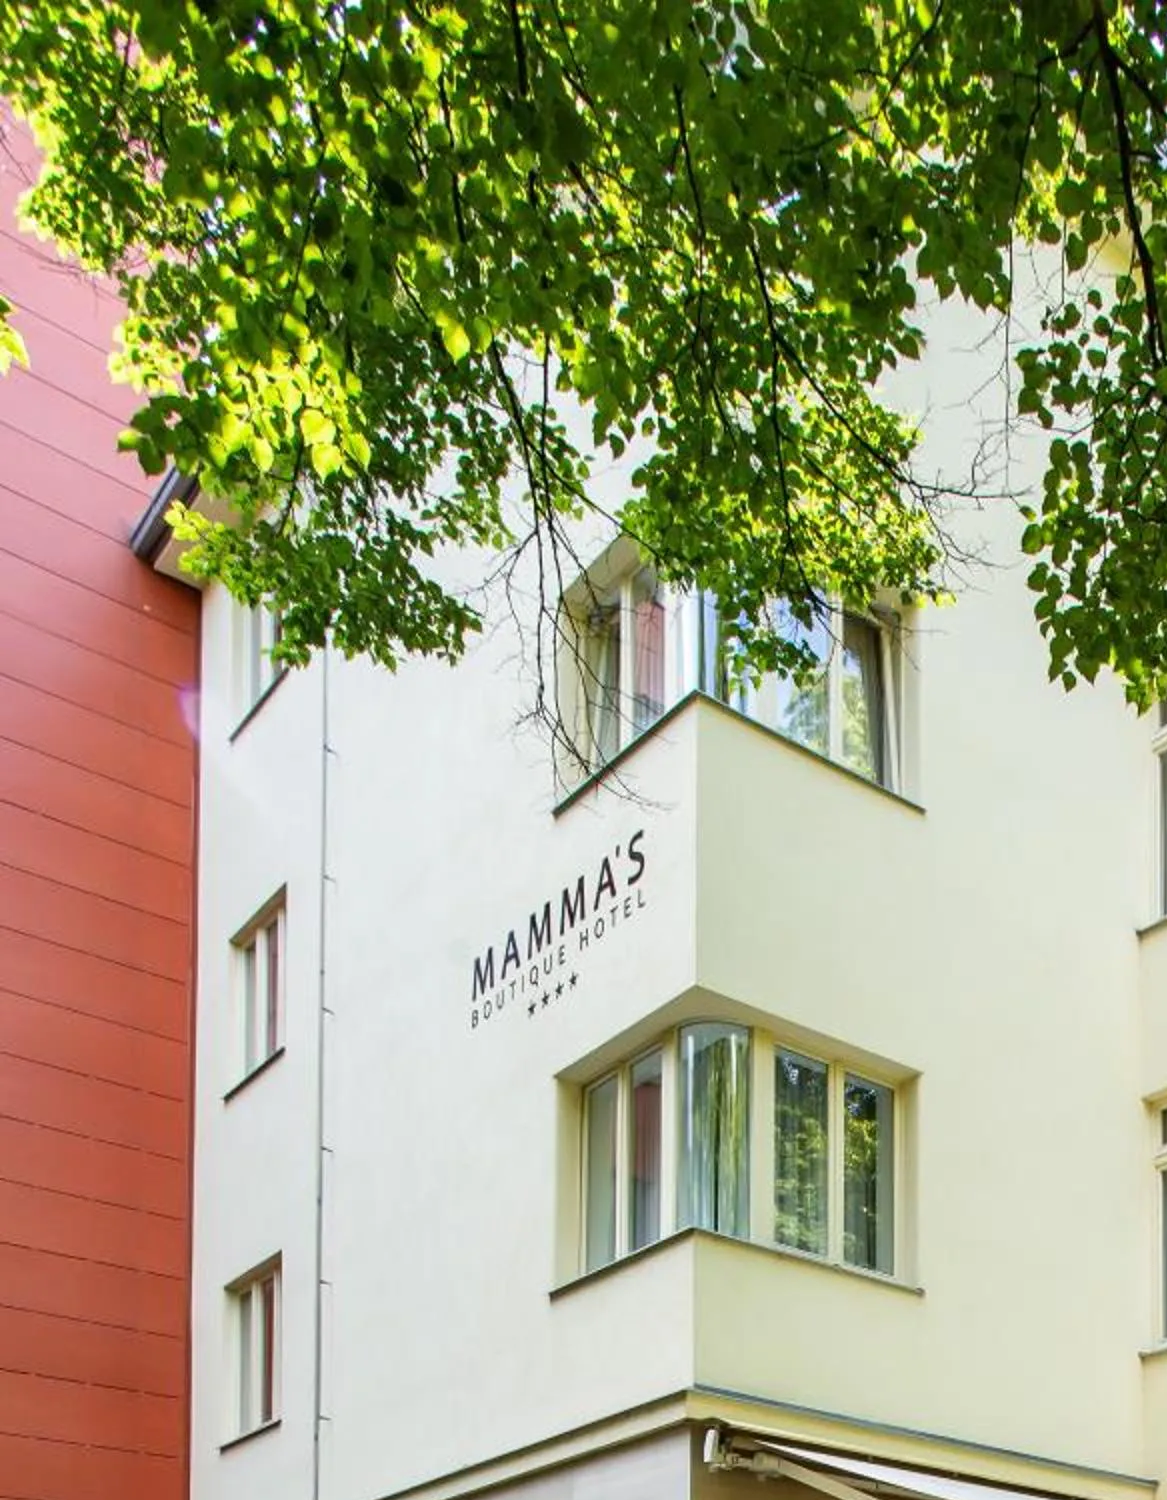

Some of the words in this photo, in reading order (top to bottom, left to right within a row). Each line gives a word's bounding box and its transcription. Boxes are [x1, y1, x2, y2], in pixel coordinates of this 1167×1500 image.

[471, 944, 567, 1029] BOUTIQUE
[579, 889, 647, 951] HOTEL
[472, 829, 646, 1002] MAMMA'S
